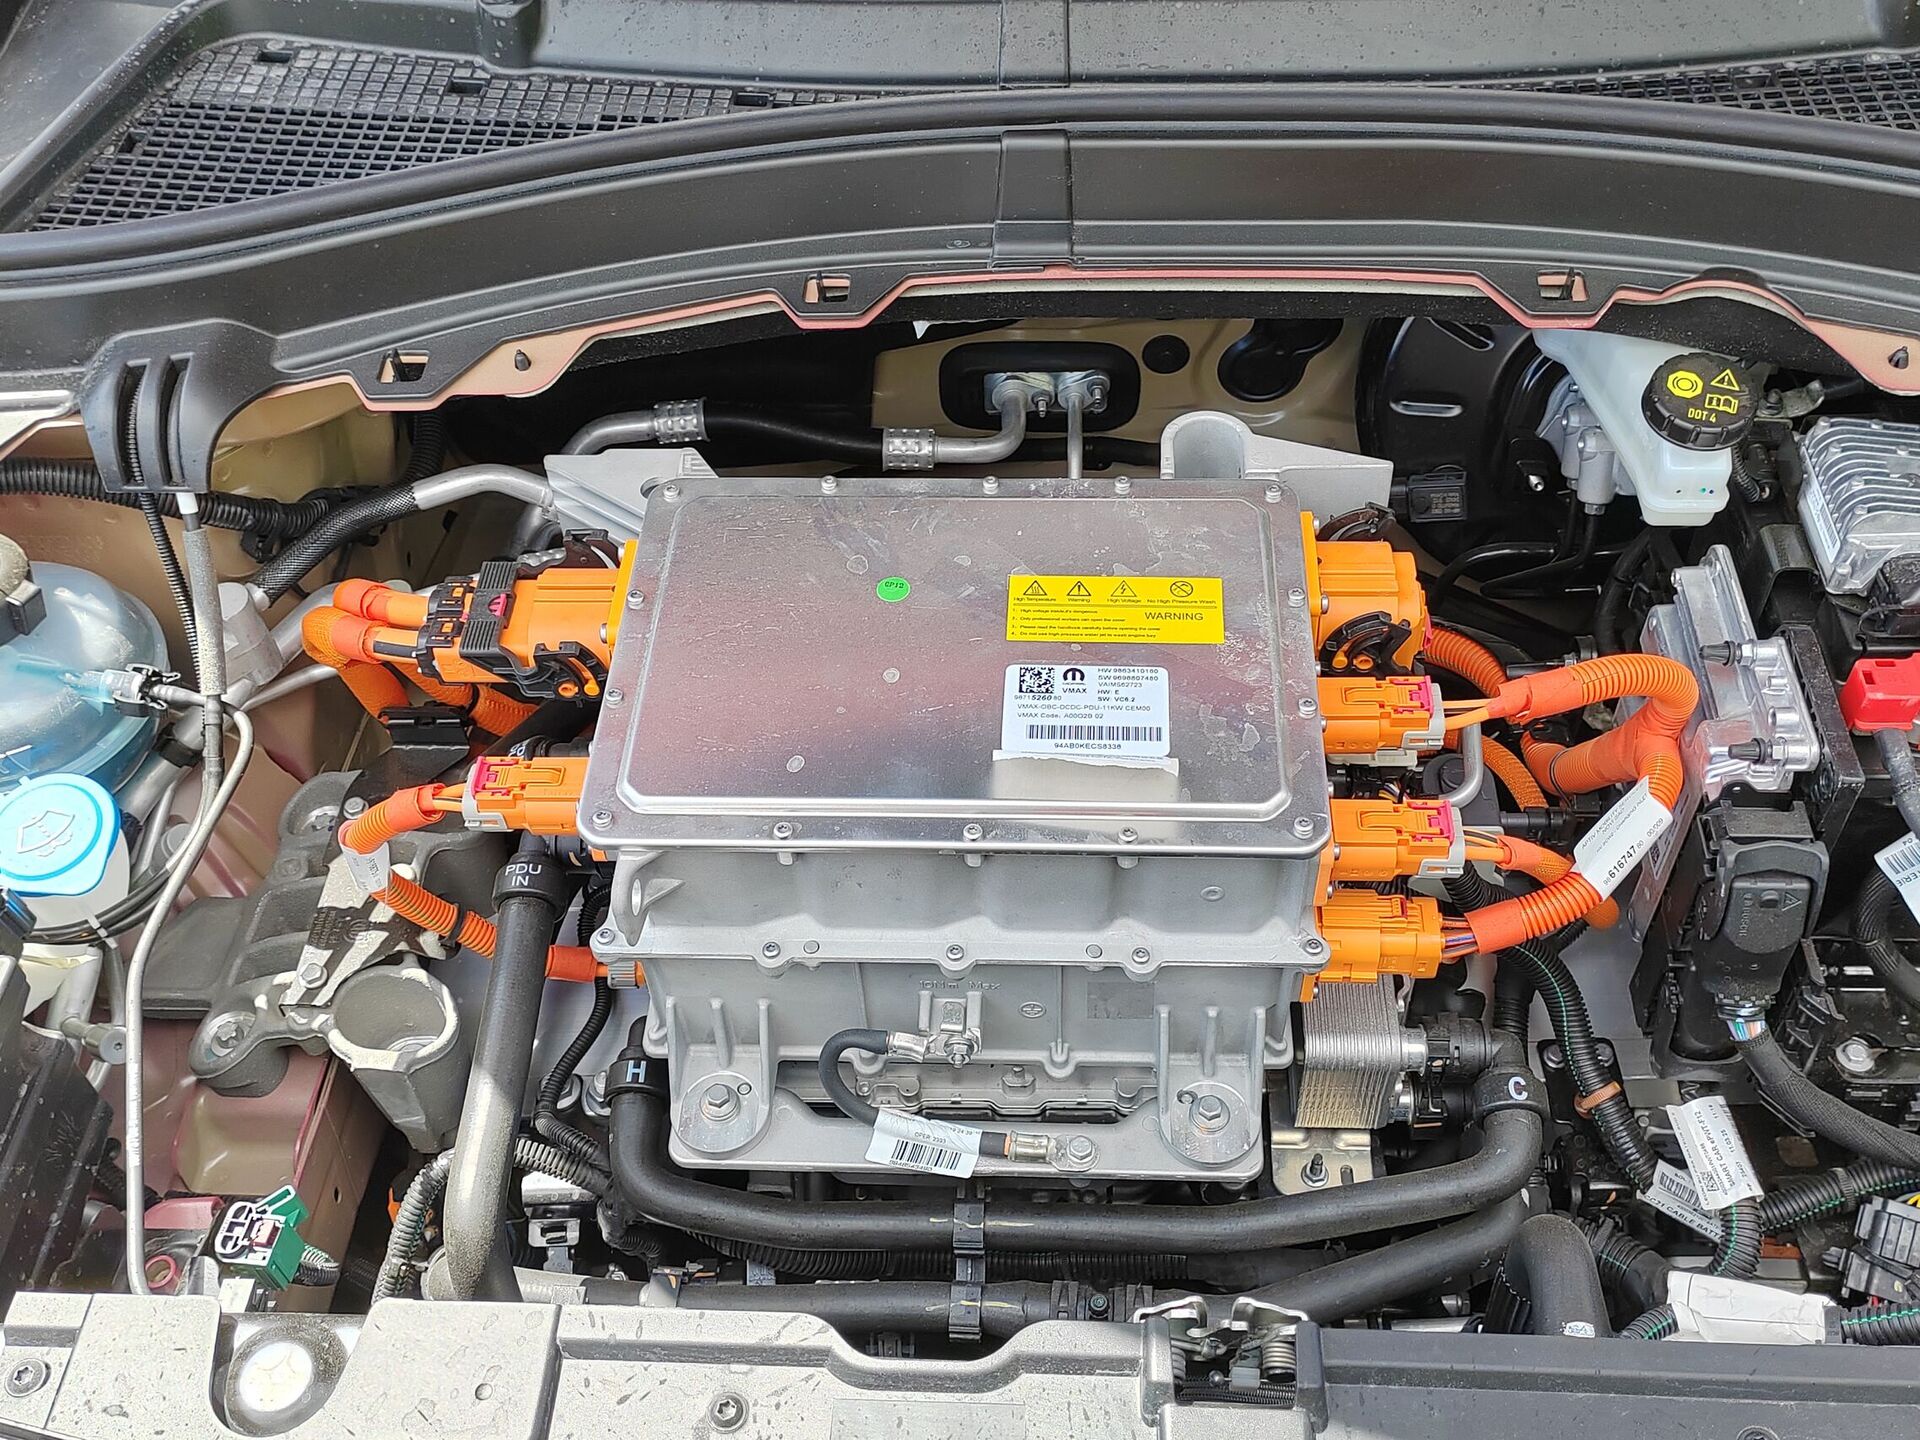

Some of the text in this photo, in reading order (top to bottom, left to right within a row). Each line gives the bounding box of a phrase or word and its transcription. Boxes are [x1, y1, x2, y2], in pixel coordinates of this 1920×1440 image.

[1688, 408, 1716, 423] DOT 4
[1145, 612, 1204, 621] WARNING
[504, 863, 542, 876] PDU
[511, 875, 529, 886] IN
[626, 1060, 647, 1083] H
[1508, 1076, 1528, 1100] C
[1710, 1144, 1724, 1162] CAR
[1719, 1161, 1735, 1187] SMART
[1666, 1205, 1694, 1226] CABLE
